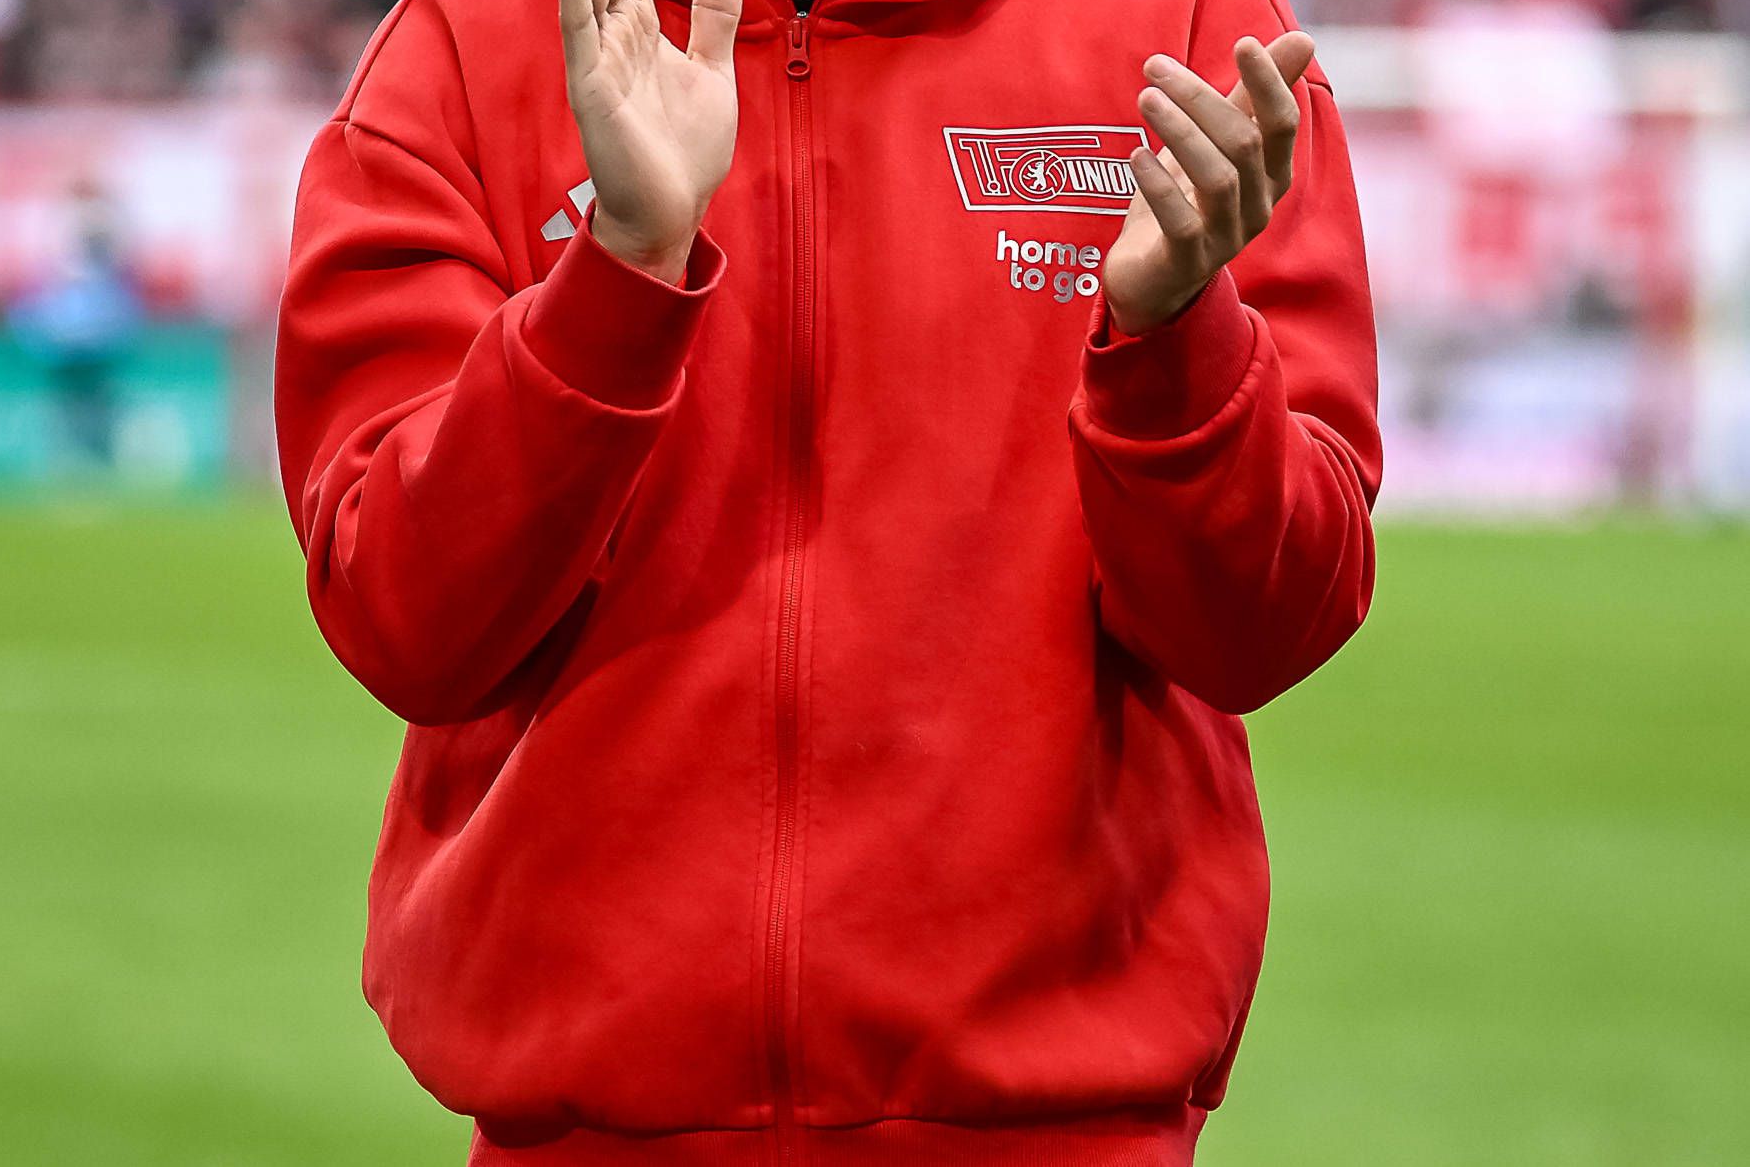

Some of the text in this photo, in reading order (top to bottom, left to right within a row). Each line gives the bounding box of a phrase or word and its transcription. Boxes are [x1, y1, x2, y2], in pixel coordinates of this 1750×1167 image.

[996, 230, 1101, 269] home
[1011, 262, 1100, 303] to go
